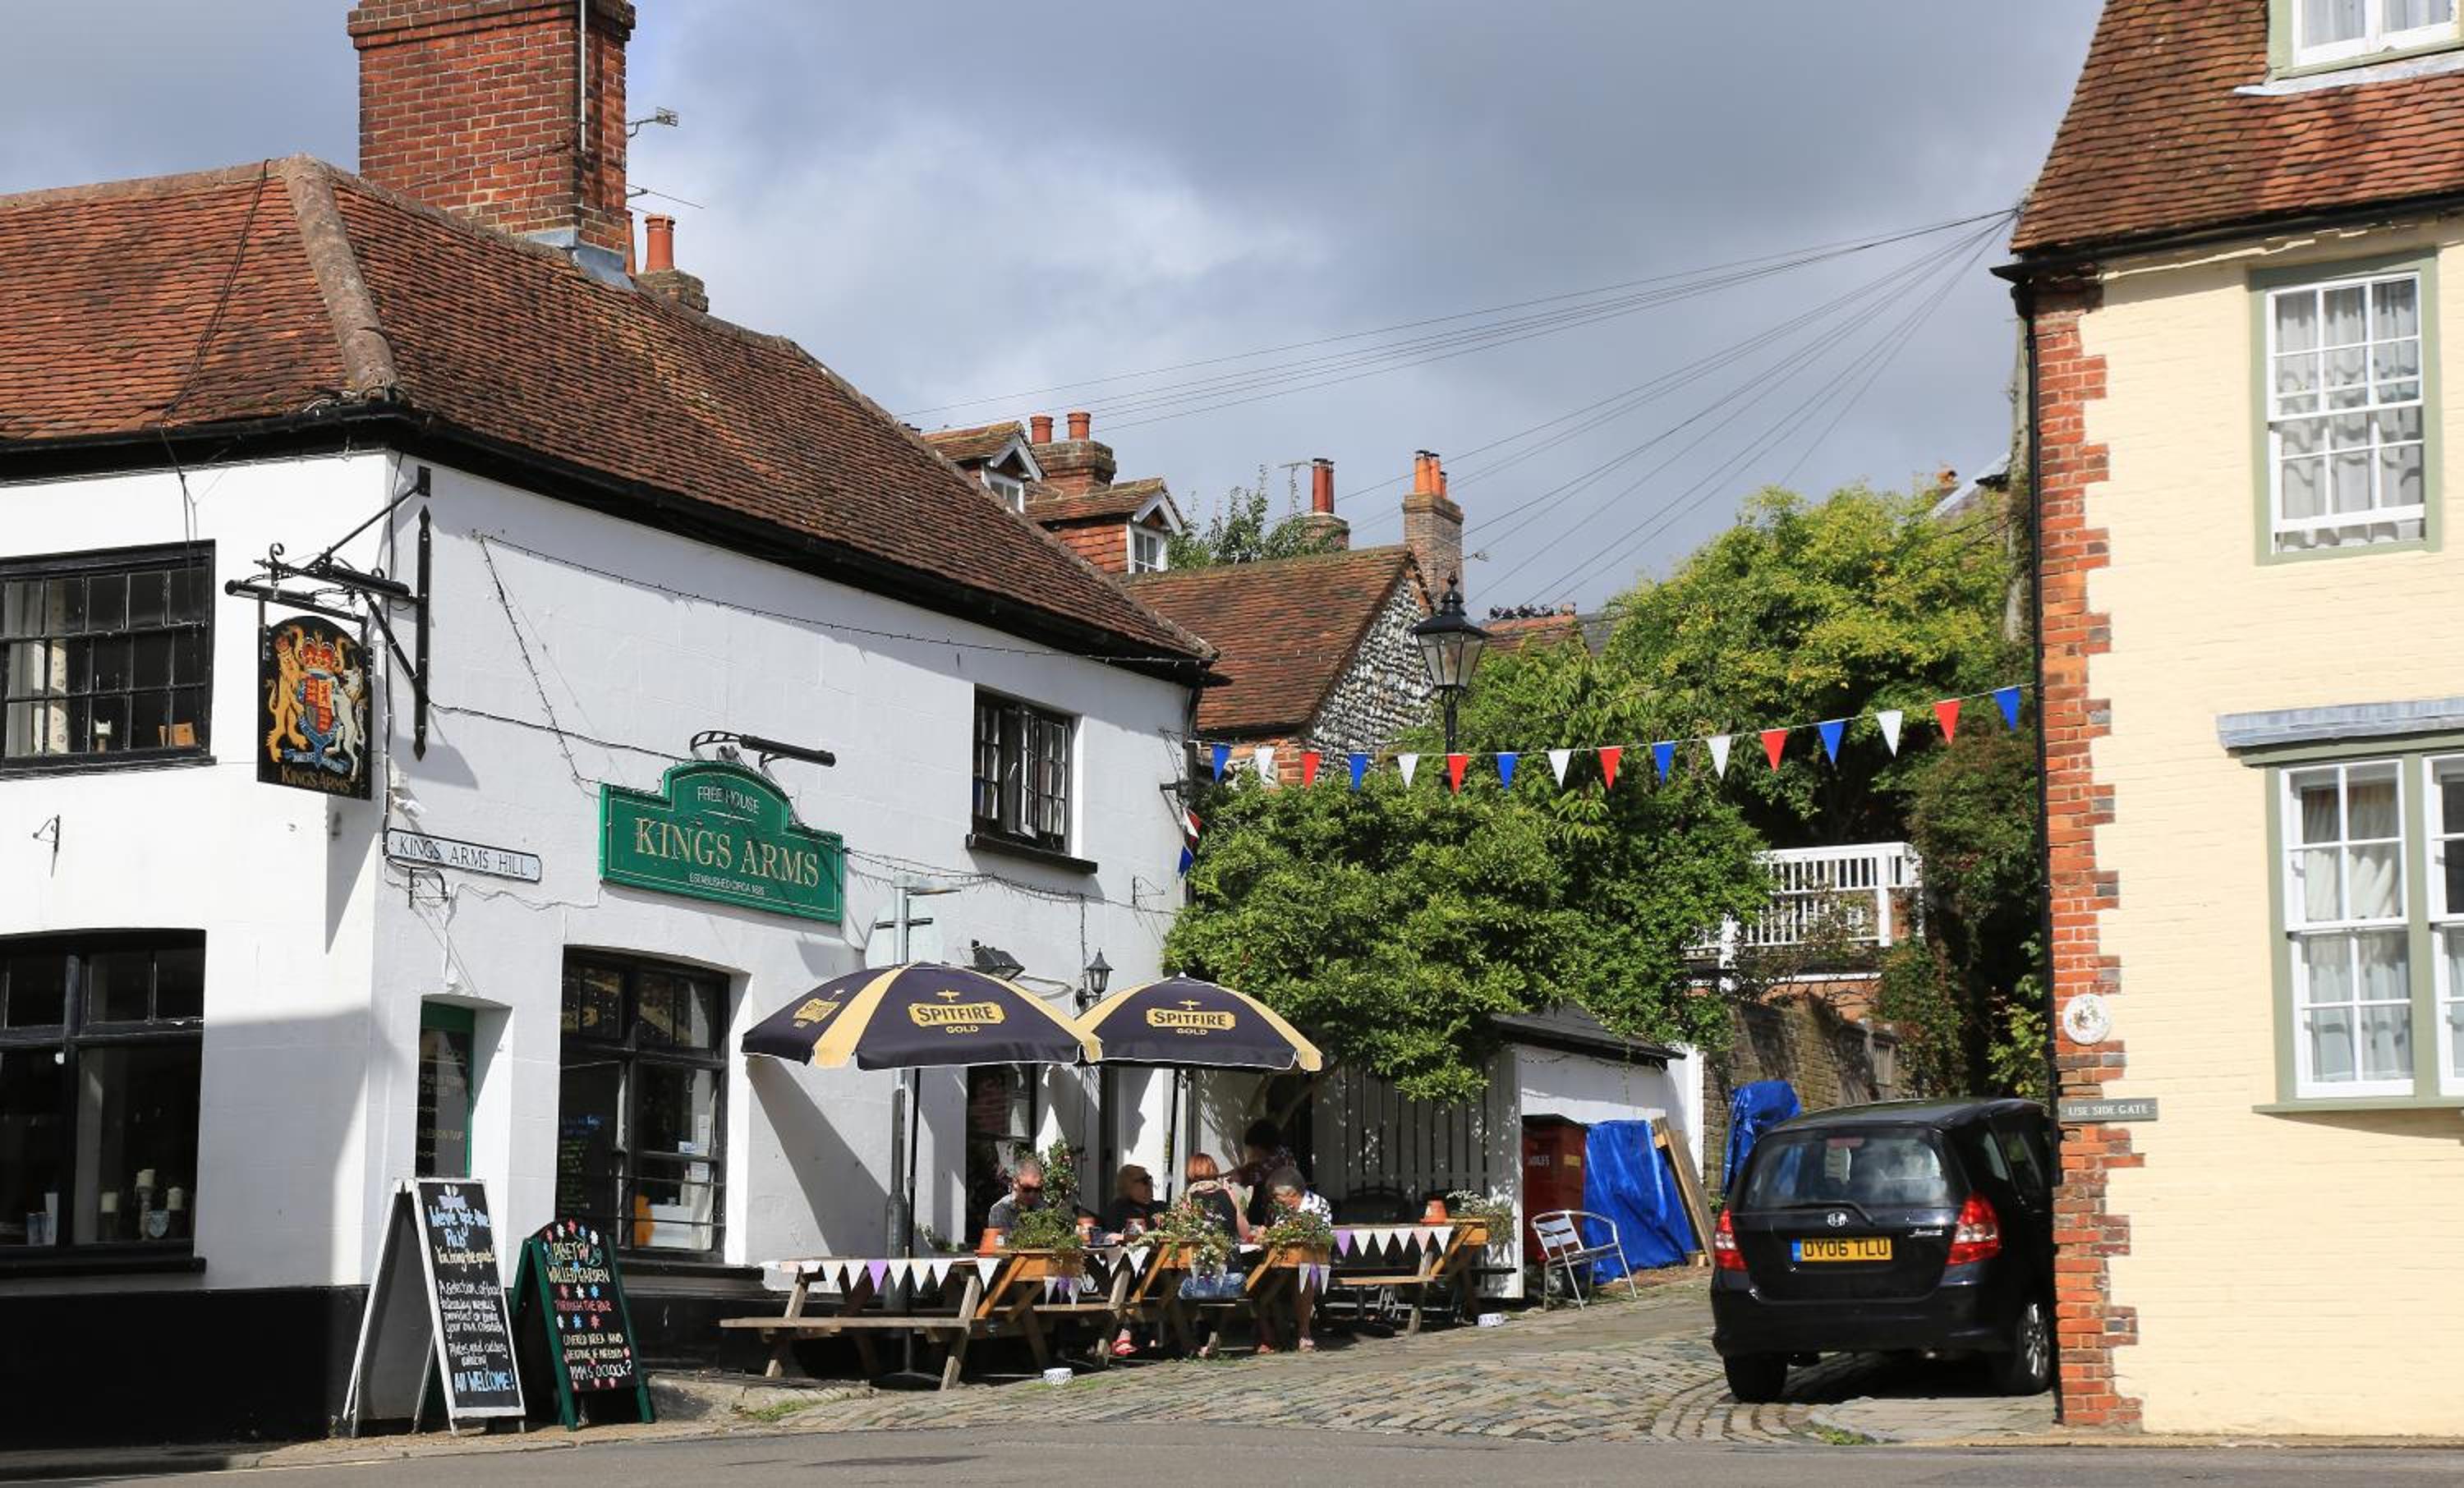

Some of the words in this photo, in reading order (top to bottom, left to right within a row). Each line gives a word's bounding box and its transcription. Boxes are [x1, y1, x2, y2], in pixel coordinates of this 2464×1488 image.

[319, 772, 351, 794] ARMS
[697, 786, 723, 802] FREE
[725, 790, 760, 815] HOUSE
[399, 836, 441, 860] KINGS
[450, 846, 490, 870] ARMS
[499, 854, 526, 876] HILL
[634, 817, 732, 870] KINGS
[740, 840, 819, 888] ARMS
[917, 1007, 995, 1022] SPITFIRE
[1154, 1012, 1226, 1026] SPITFIRE
[945, 1025, 979, 1034] GOLD
[1176, 1027, 1208, 1036] GOLD
[2069, 1105, 2089, 1116] USE
[2091, 1105, 2117, 1115] SIDE
[2118, 1104, 2149, 1114] GATE
[1854, 1238, 1887, 1256] TLU
